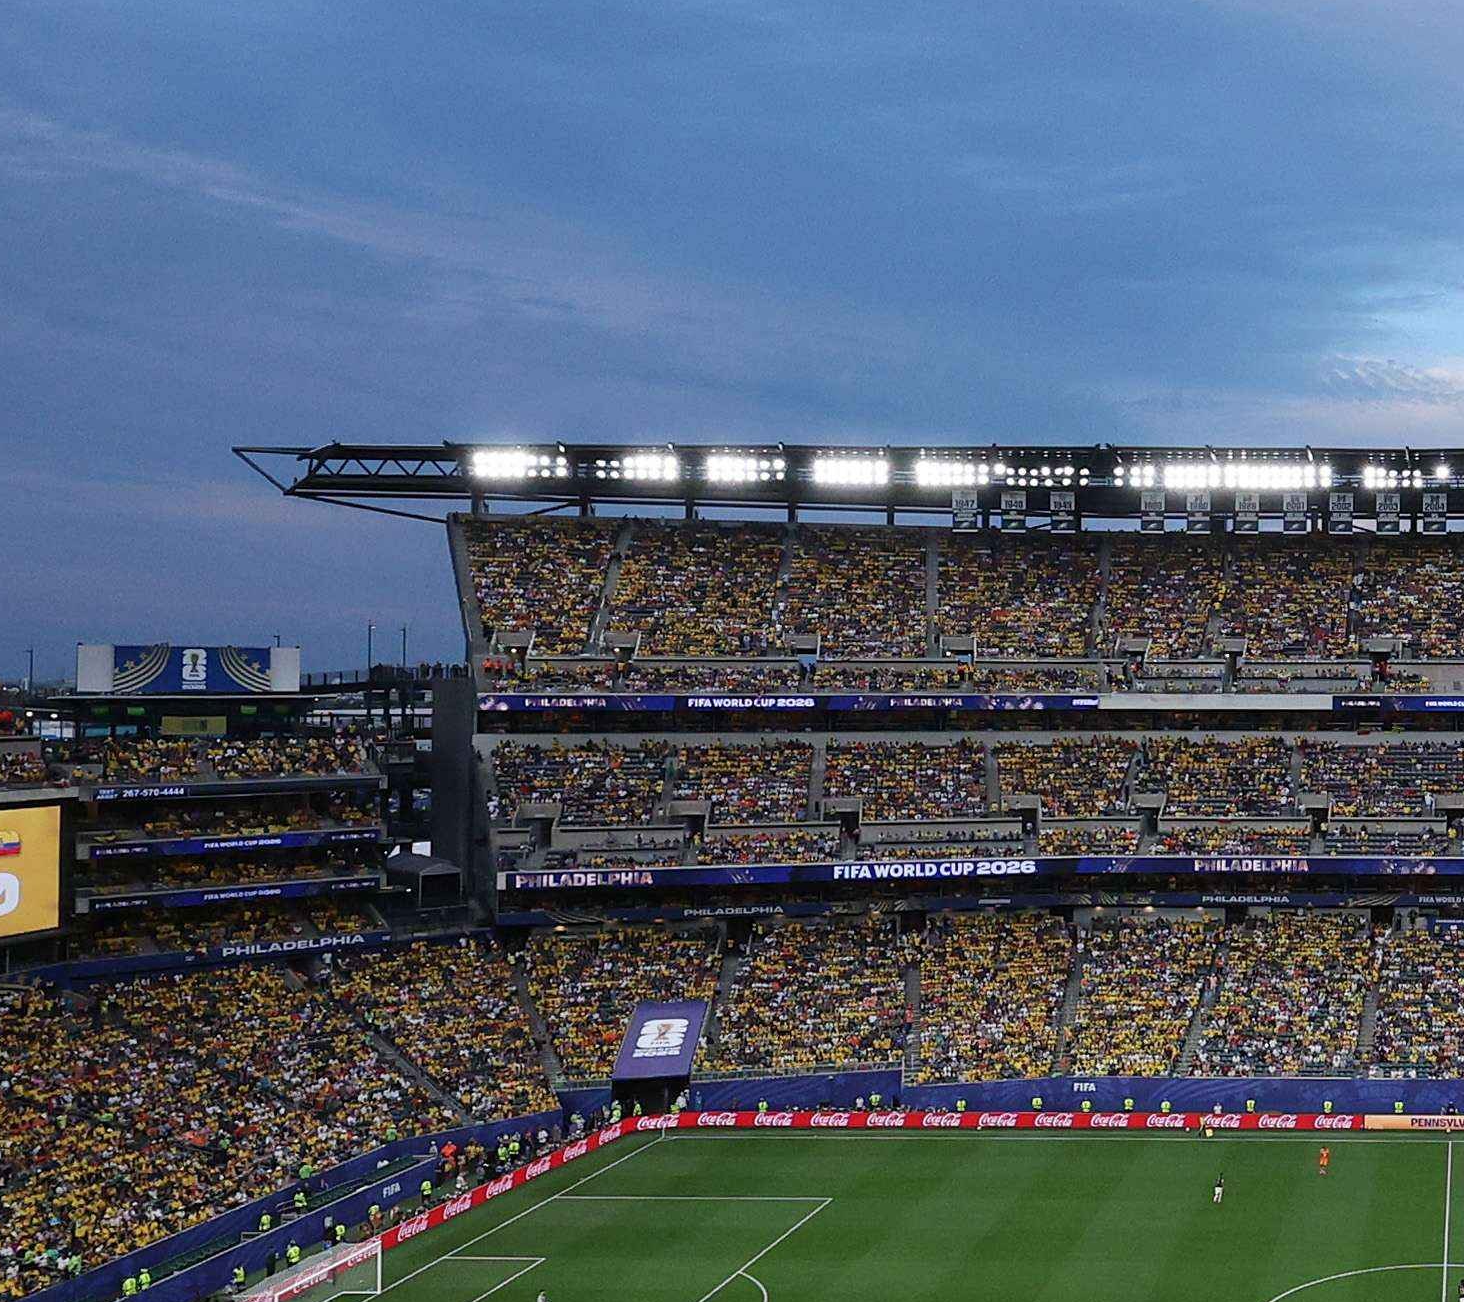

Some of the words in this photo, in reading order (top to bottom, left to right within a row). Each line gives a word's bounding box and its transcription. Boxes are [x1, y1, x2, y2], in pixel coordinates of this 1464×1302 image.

[524, 698, 606, 708] PHILADELPHIA
[688, 698, 712, 708] FIFA
[712, 698, 752, 708] WORLD
[753, 698, 776, 708] CUP
[777, 698, 815, 708] 2026
[890, 698, 963, 708] PHILADELPHIA
[833, 864, 873, 880] FIFA
[873, 862, 938, 879] WORLD
[939, 861, 975, 877] CUP
[976, 860, 1037, 875] 2026
[1194, 859, 1309, 873] PHILADELPHIA
[515, 871, 654, 889] PHILADELPHIA
[1202, 895, 1290, 904] PHILADELPHIA
[1435, 896, 1461, 904] WORLD
[684, 905, 784, 917] PHILADELPHIA
[222, 933, 365, 957] PHILADELPHIA
[1073, 1082, 1097, 1093] FIFA
[697, 1112, 736, 1127] Coca-Cola
[753, 1112, 793, 1127] Coca-Cola
[810, 1112, 850, 1127] Coca-Cola
[866, 1112, 906, 1127] Coca-Cola
[922, 1112, 962, 1127] Coca-Cola
[978, 1113, 1018, 1128] Coca-Cola
[1034, 1112, 1073, 1127] Coca-Cola
[1090, 1113, 1129, 1128] Coca-Cola
[1146, 1113, 1185, 1128] Coca-Cola
[1257, 1113, 1297, 1128] Coca-Cola
[1313, 1113, 1353, 1129] Coca-Cola
[598, 1124, 623, 1146] Coca-Cola
[562, 1139, 588, 1163] Coca-Cola
[525, 1156, 552, 1181] Coca-Cola
[382, 1181, 401, 1199] FIFA
[485, 1174, 514, 1199] Coca-Cola
[443, 1193, 473, 1221] Coca-Cola
[397, 1215, 429, 1242] Coca-Cola
